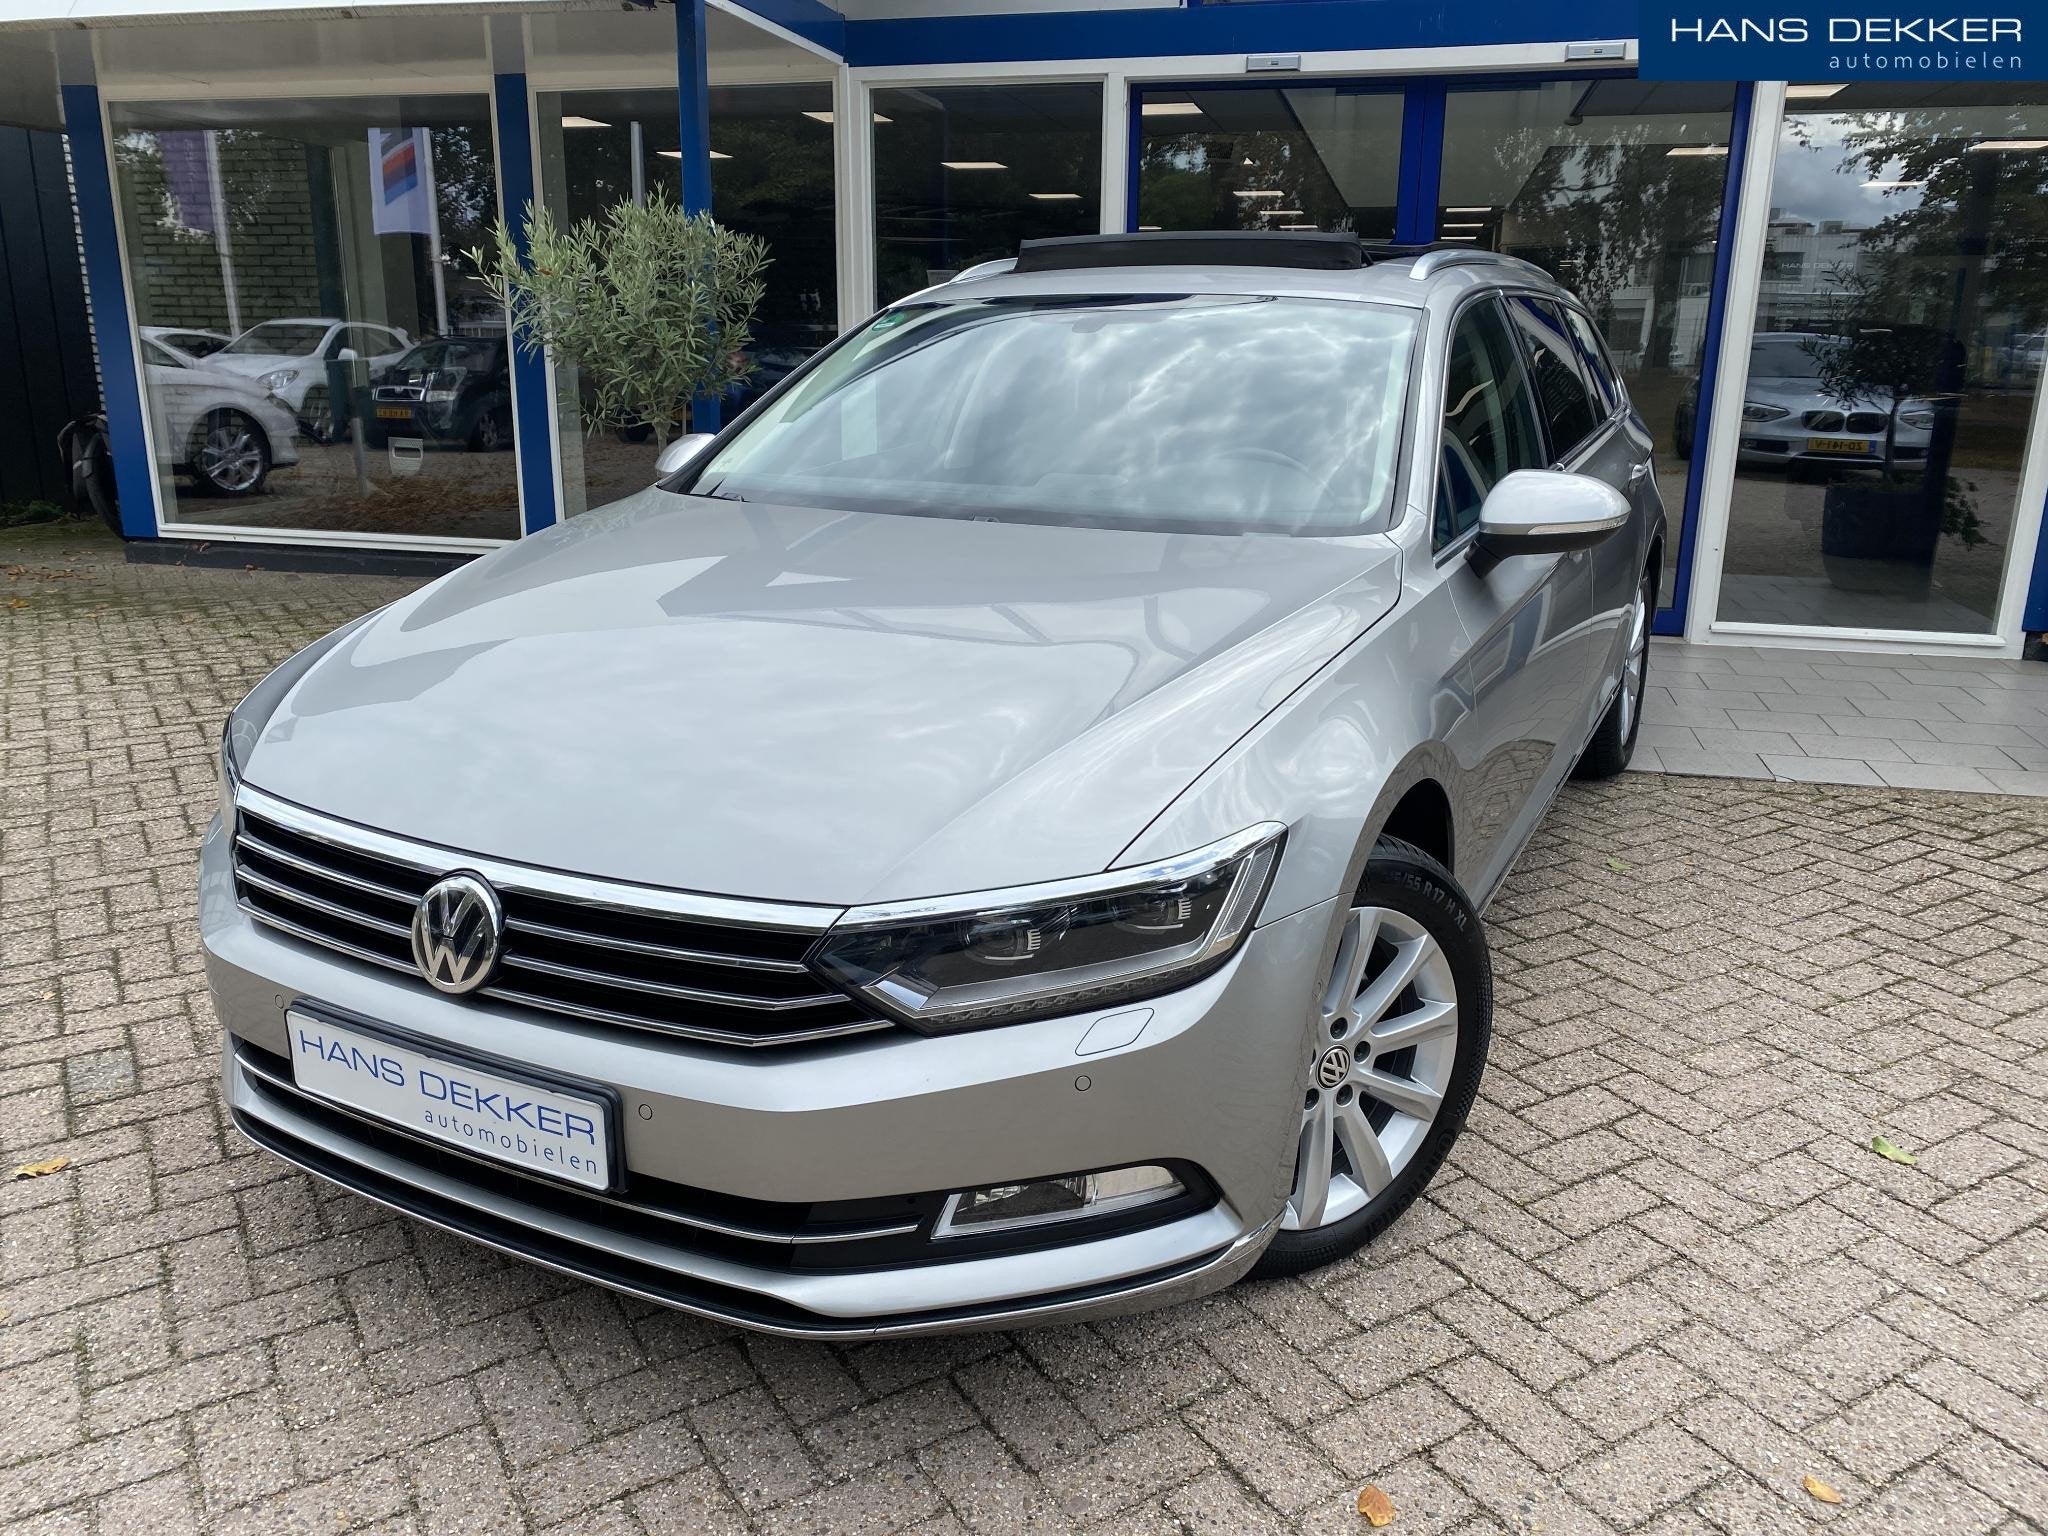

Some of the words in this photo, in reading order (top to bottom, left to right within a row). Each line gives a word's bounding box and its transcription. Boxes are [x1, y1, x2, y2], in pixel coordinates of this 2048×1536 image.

[299, 1029, 406, 1087] HANS
[418, 1069, 596, 1146] DEKKER
[424, 1108, 598, 1175] automobielen
